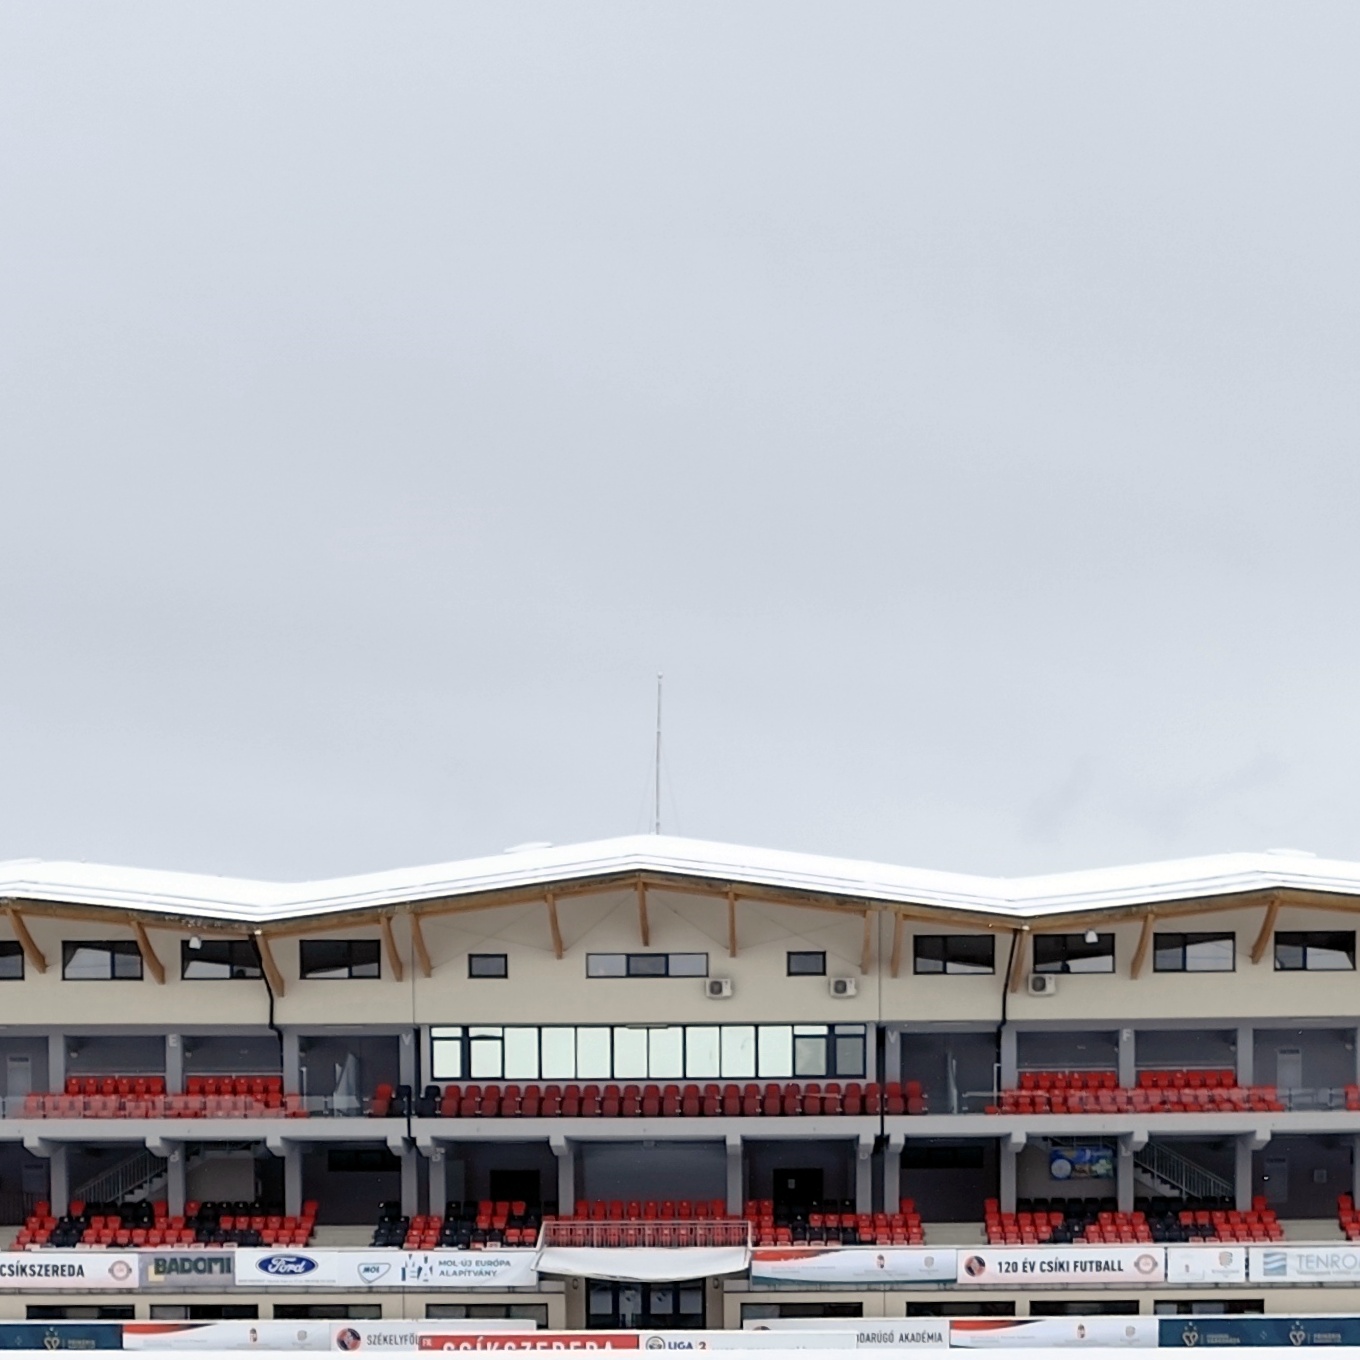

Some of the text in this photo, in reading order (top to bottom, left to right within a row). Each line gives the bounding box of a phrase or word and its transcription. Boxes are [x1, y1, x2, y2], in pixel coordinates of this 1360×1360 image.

[169, 1034, 177, 1047] E
[402, 1034, 411, 1045] V
[887, 1031, 896, 1043] V
[1123, 1029, 1132, 1041] F
[0, 1260, 84, 1277] CSÍKSZEREDA
[154, 1257, 231, 1275] BADOMI
[269, 1257, 305, 1274] Ford
[475, 1258, 511, 1267] EURÓPA
[998, 1257, 1123, 1273] 120 ÉV CSÍKI FUTBALL
[439, 1267, 497, 1277] ALAPÍTVÁNY
[899, 1331, 943, 1343] AKADÉMIA
